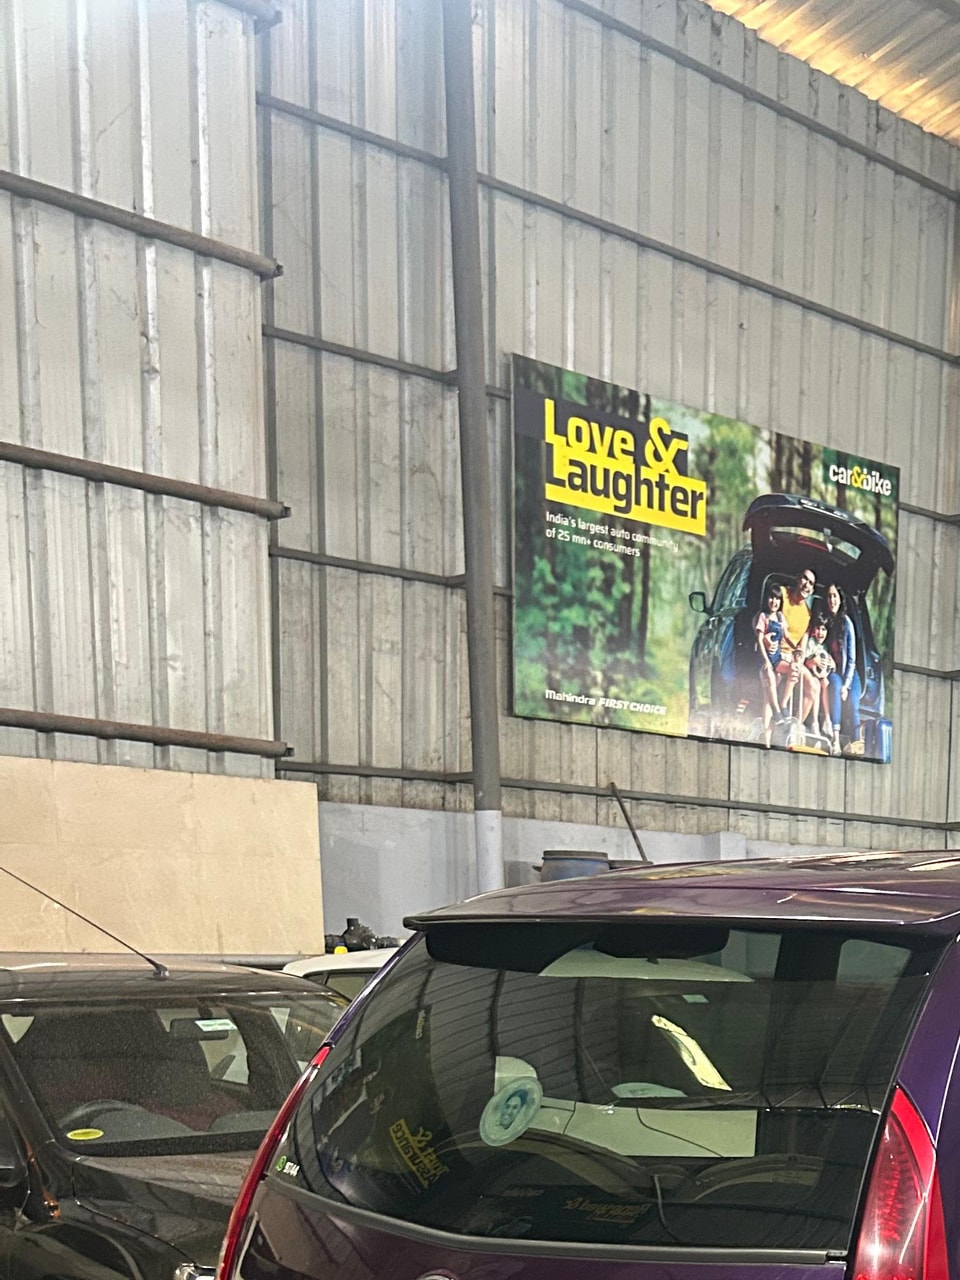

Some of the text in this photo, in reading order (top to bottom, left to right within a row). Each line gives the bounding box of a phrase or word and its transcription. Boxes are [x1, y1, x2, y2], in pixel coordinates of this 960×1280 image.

[545, 398, 688, 476] Love &
[546, 440, 703, 519] Laughter
[829, 465, 891, 495] car&bike
[546, 511, 679, 553] India's largest auto community
[546, 528, 640, 557] of 25 mn+ consumers
[598, 698, 630, 710] FIRST
